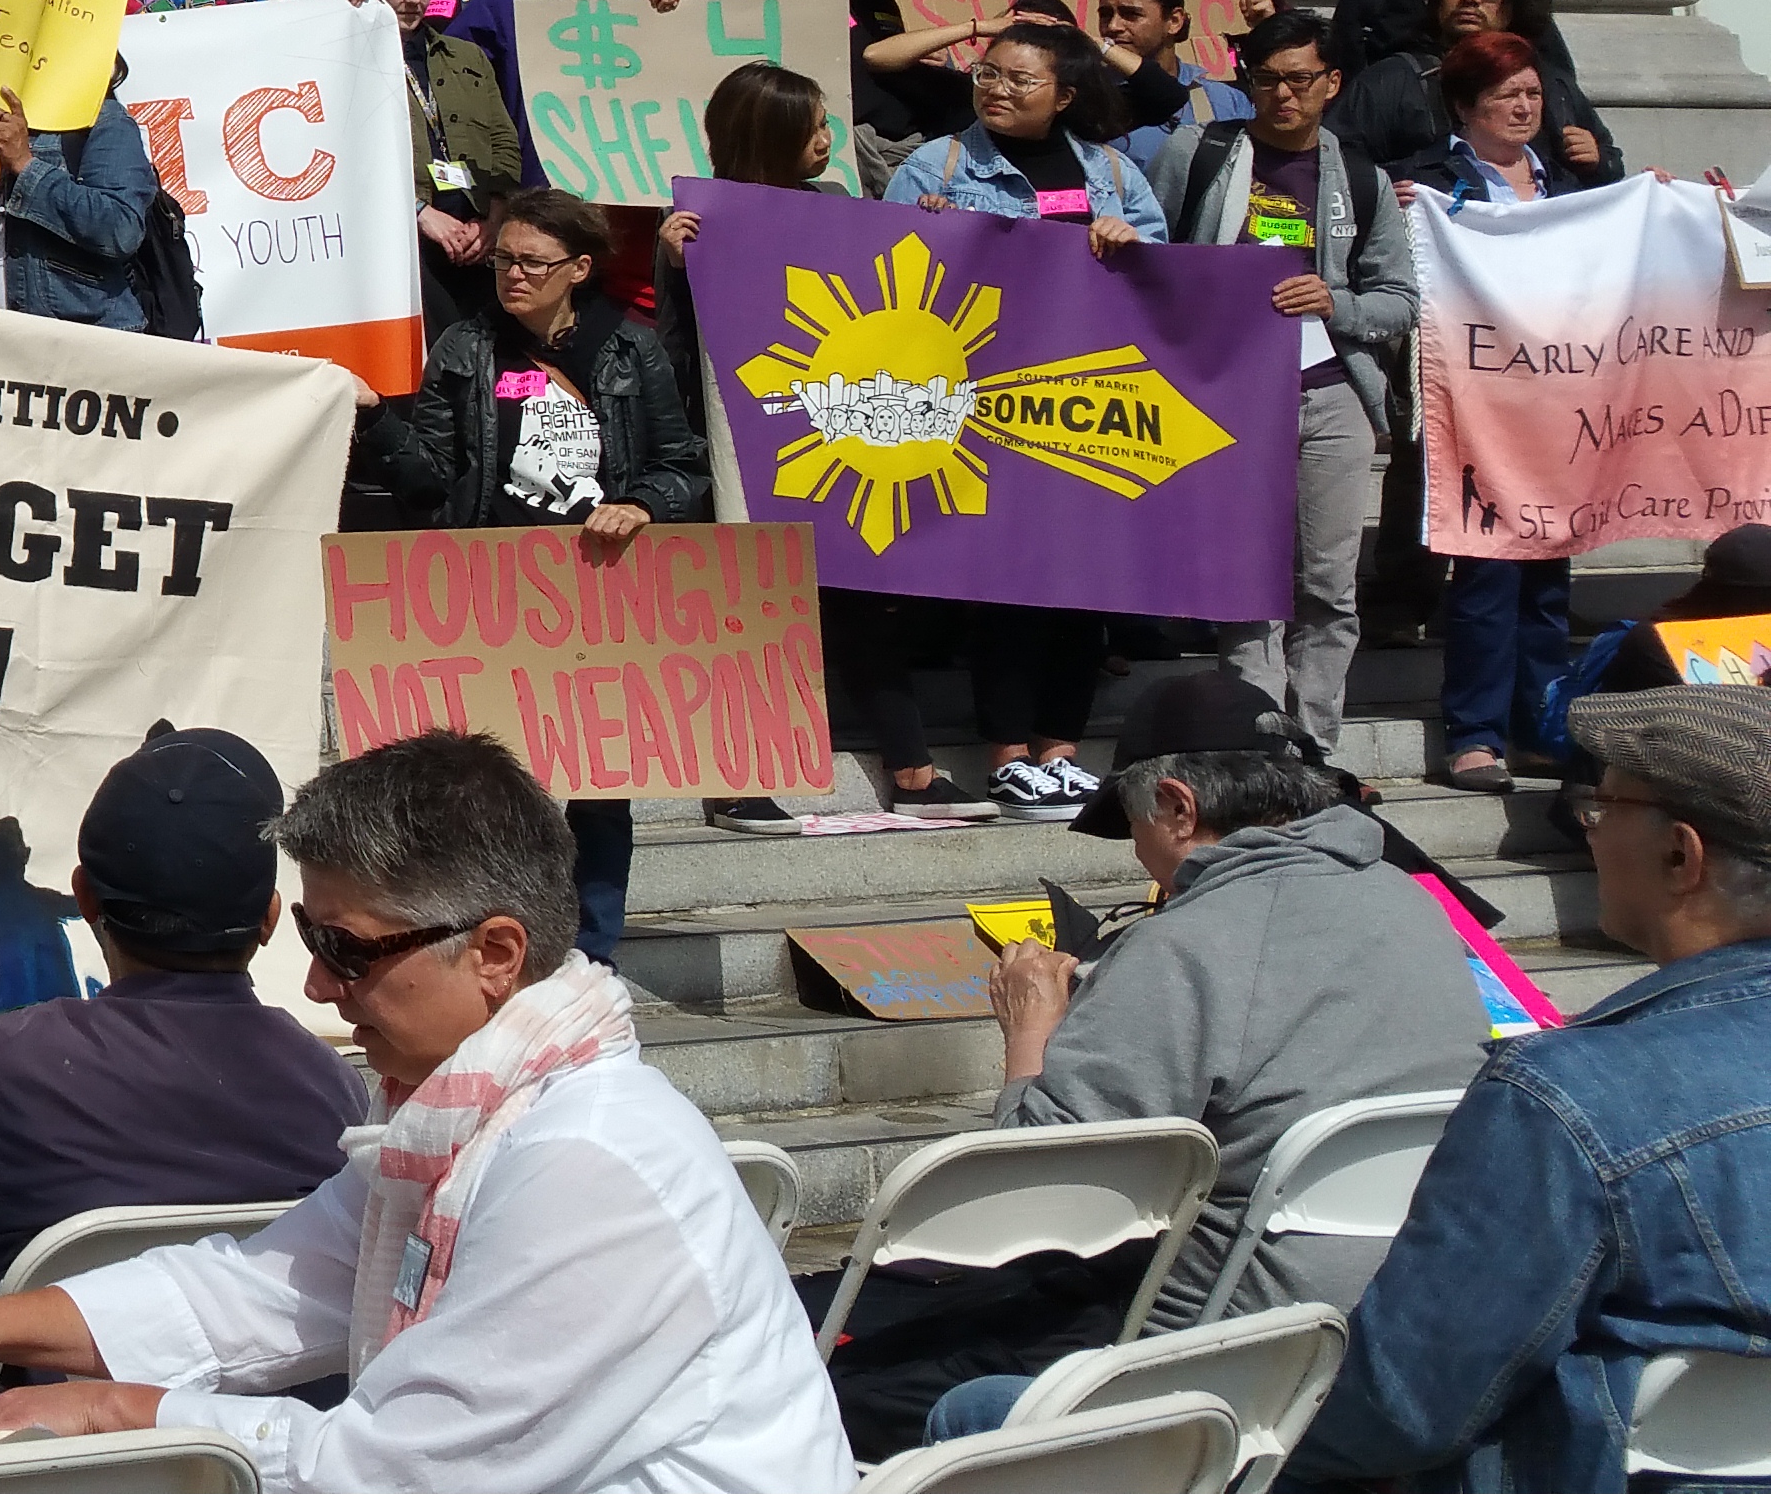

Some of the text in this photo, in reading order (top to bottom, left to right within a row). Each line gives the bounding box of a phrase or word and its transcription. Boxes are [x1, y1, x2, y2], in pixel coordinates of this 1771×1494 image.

[221, 212, 344, 269] YOUTH
[1261, 221, 1300, 230] BUDGET
[1463, 315, 1755, 378] EARLY CARE AND
[1017, 372, 1140, 395] SOUTH OF MARKET
[543, 429, 600, 442] COMMITTE
[975, 392, 1162, 446] SOMCAN
[1679, 406, 1713, 437] A
[559, 447, 598, 458] OF SAN
[986, 434, 1178, 468] COMMUNITY ACTION NETWORK
[1518, 504, 1555, 541] SF
[1617, 483, 1692, 520] Care
[1705, 487, 1771, 522] Provi
[328, 524, 810, 648] HOUSING!!!
[511, 622, 834, 793] WEAPONS
